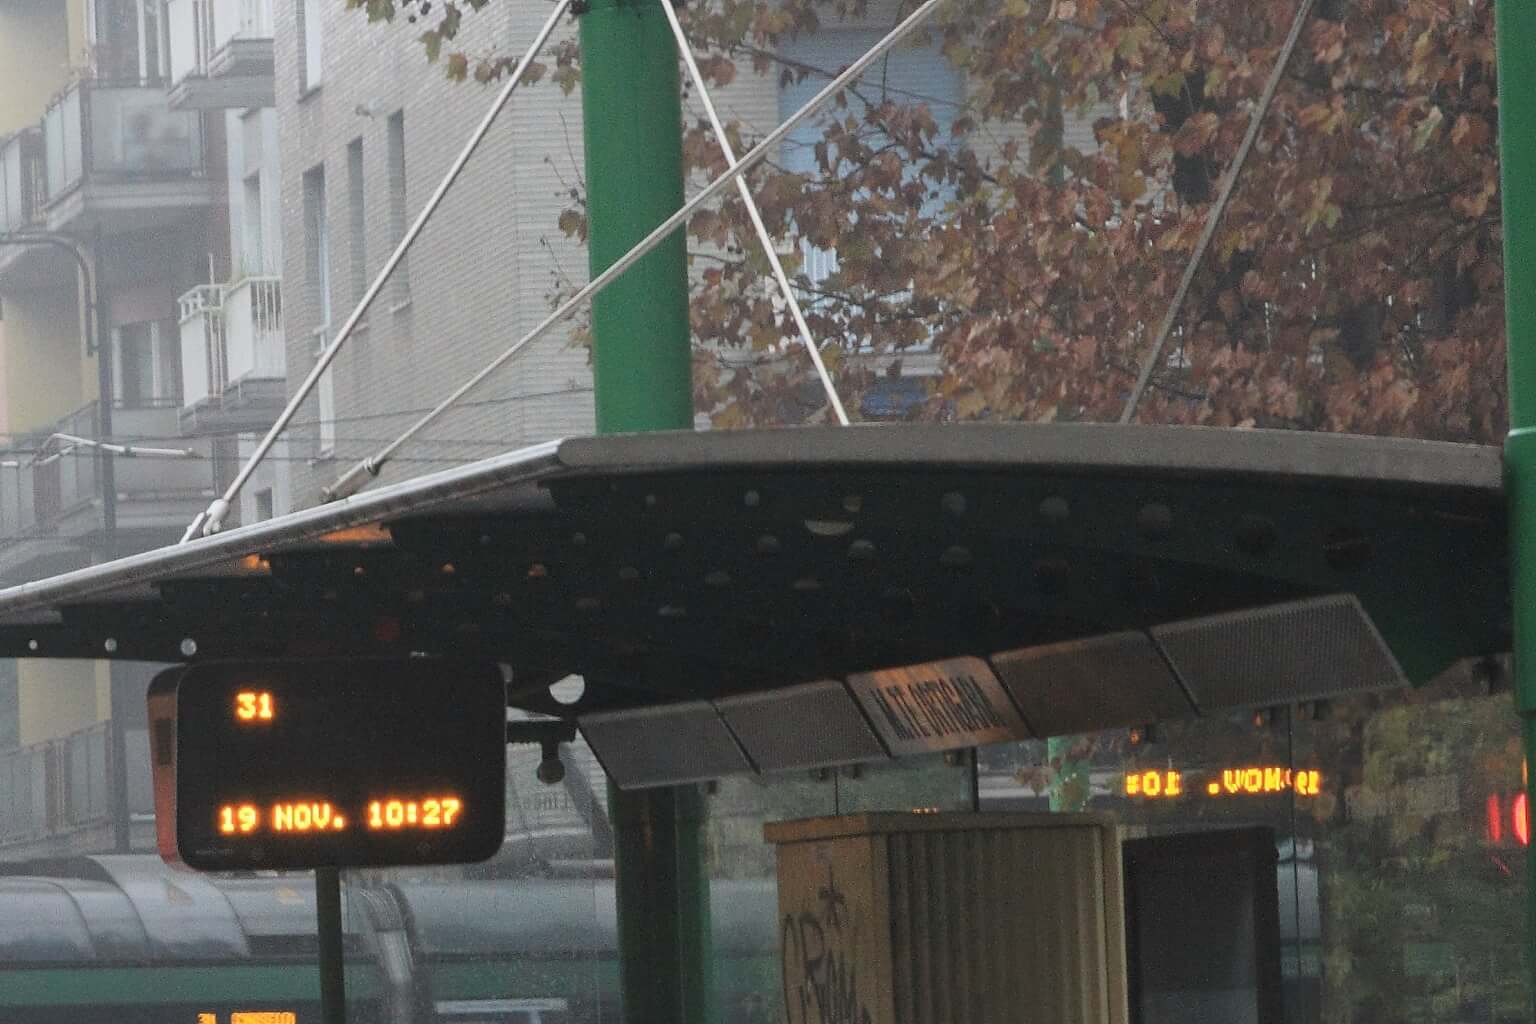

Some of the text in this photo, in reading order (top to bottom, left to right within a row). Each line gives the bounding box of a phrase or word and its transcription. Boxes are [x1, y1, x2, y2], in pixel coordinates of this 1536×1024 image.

[236, 692, 273, 719] 31
[220, 799, 460, 832] 19 NOV. 10:27
